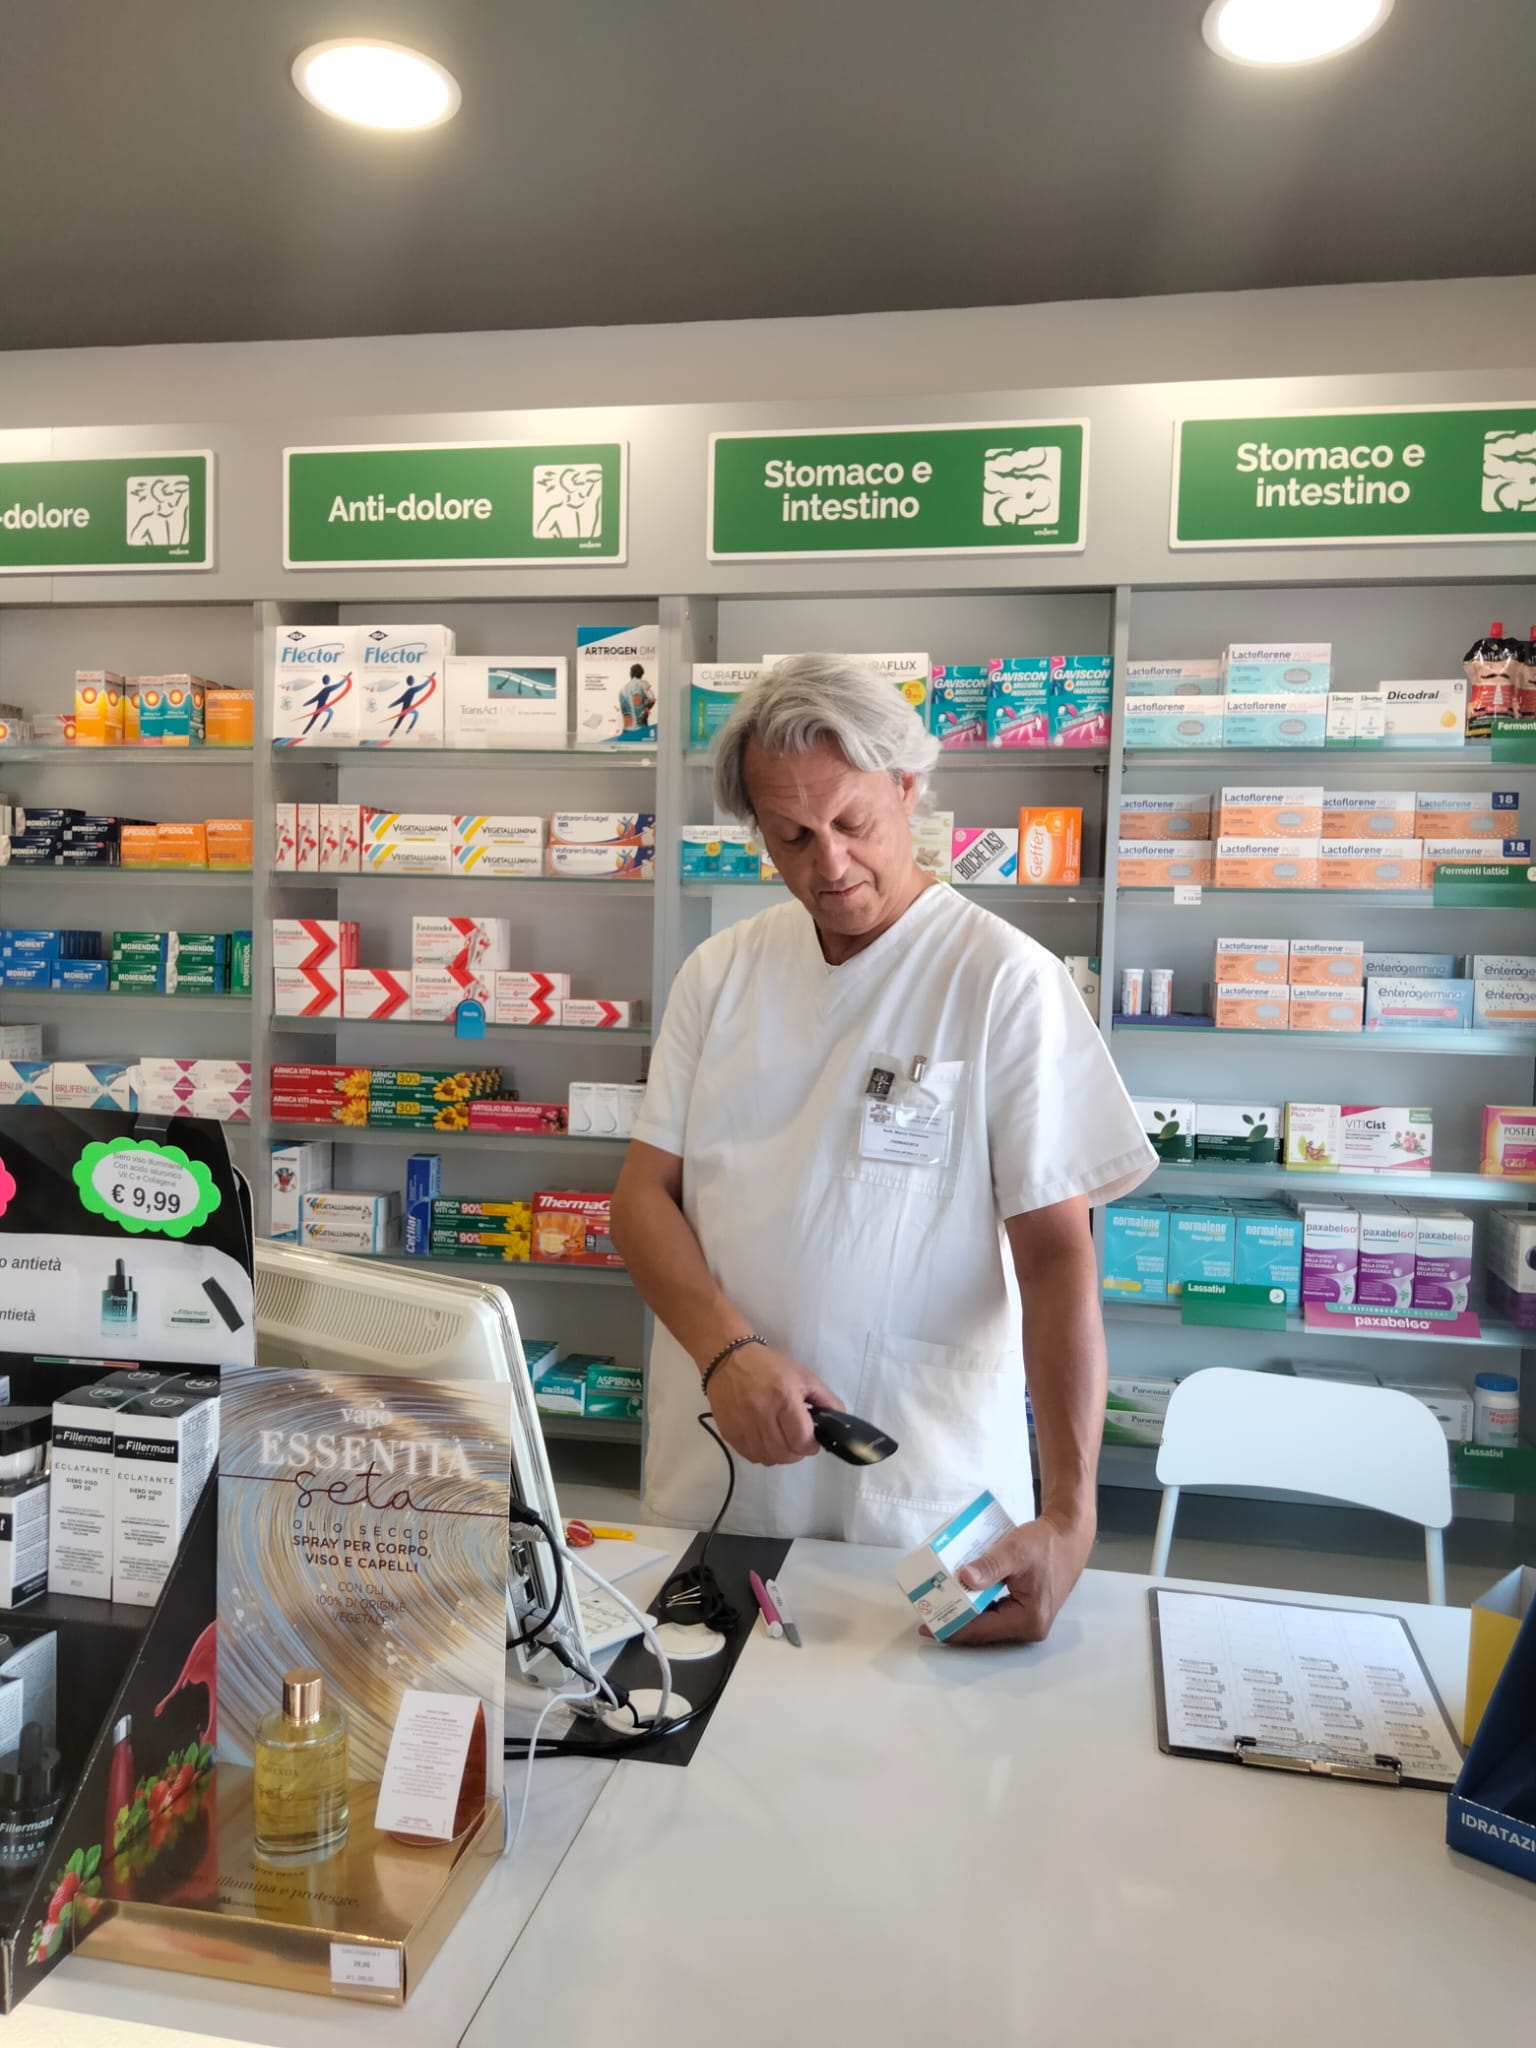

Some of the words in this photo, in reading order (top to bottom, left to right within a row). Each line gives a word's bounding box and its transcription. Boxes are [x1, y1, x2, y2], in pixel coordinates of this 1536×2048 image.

[1236, 442, 1394, 472] Stomaco
[1402, 444, 1425, 468] e
[764, 460, 904, 488] Stomaco
[912, 461, 932, 483] e
[1256, 474, 1410, 508] intestino
[328, 493, 492, 522] Anti-dolore
[782, 491, 919, 522] intestino
[281, 647, 342, 663] Flector
[364, 647, 424, 663] Flector
[585, 646, 637, 655] ARTROGEN
[1232, 650, 1291, 659] Lactoflorene
[701, 670, 759, 680] CURAFLUX
[991, 671, 1047, 682] GAVISCON
[1054, 669, 1110, 680] GAVISCON
[1127, 667, 1182, 676] Lactoflorene
[934, 679, 987, 688] GAVISCON
[1387, 691, 1440, 700] Dicodral
[1127, 703, 1185, 712] Lactoflorene
[1227, 702, 1286, 711] Lactoflorene
[1224, 793, 1283, 802] Lactoflorene
[1323, 798, 1376, 807] actoflorene
[1499, 795, 1513, 804] 18
[1419, 800, 1472, 808] Lactoflorene
[1118, 846, 1175, 855] Lactoflorene
[1220, 845, 1279, 854] Lactoflorene
[1322, 846, 1382, 855] Lactoflorene
[1428, 847, 1482, 855] Lactoflorene
[1510, 842, 1525, 851] 18
[955, 830, 1006, 881] BIOCHETASI
[1030, 827, 1043, 877] Geffer
[1440, 866, 1482, 875] Fermenti
[1483, 866, 1509, 875] lattici
[15, 940, 45, 948] MOMENT
[121, 943, 160, 951] MOMENDOL
[1220, 942, 1268, 950] Lactoflorene
[1293, 944, 1343, 952] Lactoflorene
[1366, 963, 1446, 976] enterogermina
[118, 974, 156, 982] MOMENDOL
[1221, 987, 1269, 995] Lactoflorene
[1293, 989, 1343, 997] Lactoflorene
[1378, 988, 1463, 1000] enterogermina
[1346, 1120, 1386, 1129] VITICist
[113, 1162, 128, 1170] Con
[112, 1184, 125, 1203] €
[133, 1187, 181, 1214] 9,99
[461, 1203, 483, 1214] 90%
[11, 1256, 62, 1272] antietà
[1188, 1283, 1225, 1293] Lassativi
[597, 1376, 641, 1386] ASPIRINA
[64, 1431, 111, 1446] Fillermast
[125, 1441, 175, 1455] Fillermast
[1464, 1447, 1503, 1458] Lassativi
[259, 1430, 473, 1480] ESSENTIA
[294, 1461, 424, 1510] seta
[293, 1520, 342, 1533] OLIO
[360, 1525, 428, 1540] SECCO
[293, 1535, 339, 1549] SPRAY
[344, 1540, 370, 1552] PER
[376, 1541, 432, 1559] CORPO,
[305, 1553, 339, 1567] VISO
[344, 1557, 352, 1567] E
[358, 1557, 418, 1574] CAPELLI
[338, 1581, 363, 1593] CON
[366, 1583, 384, 1595] OLI
[360, 1598, 406, 1612] ORIGINE
